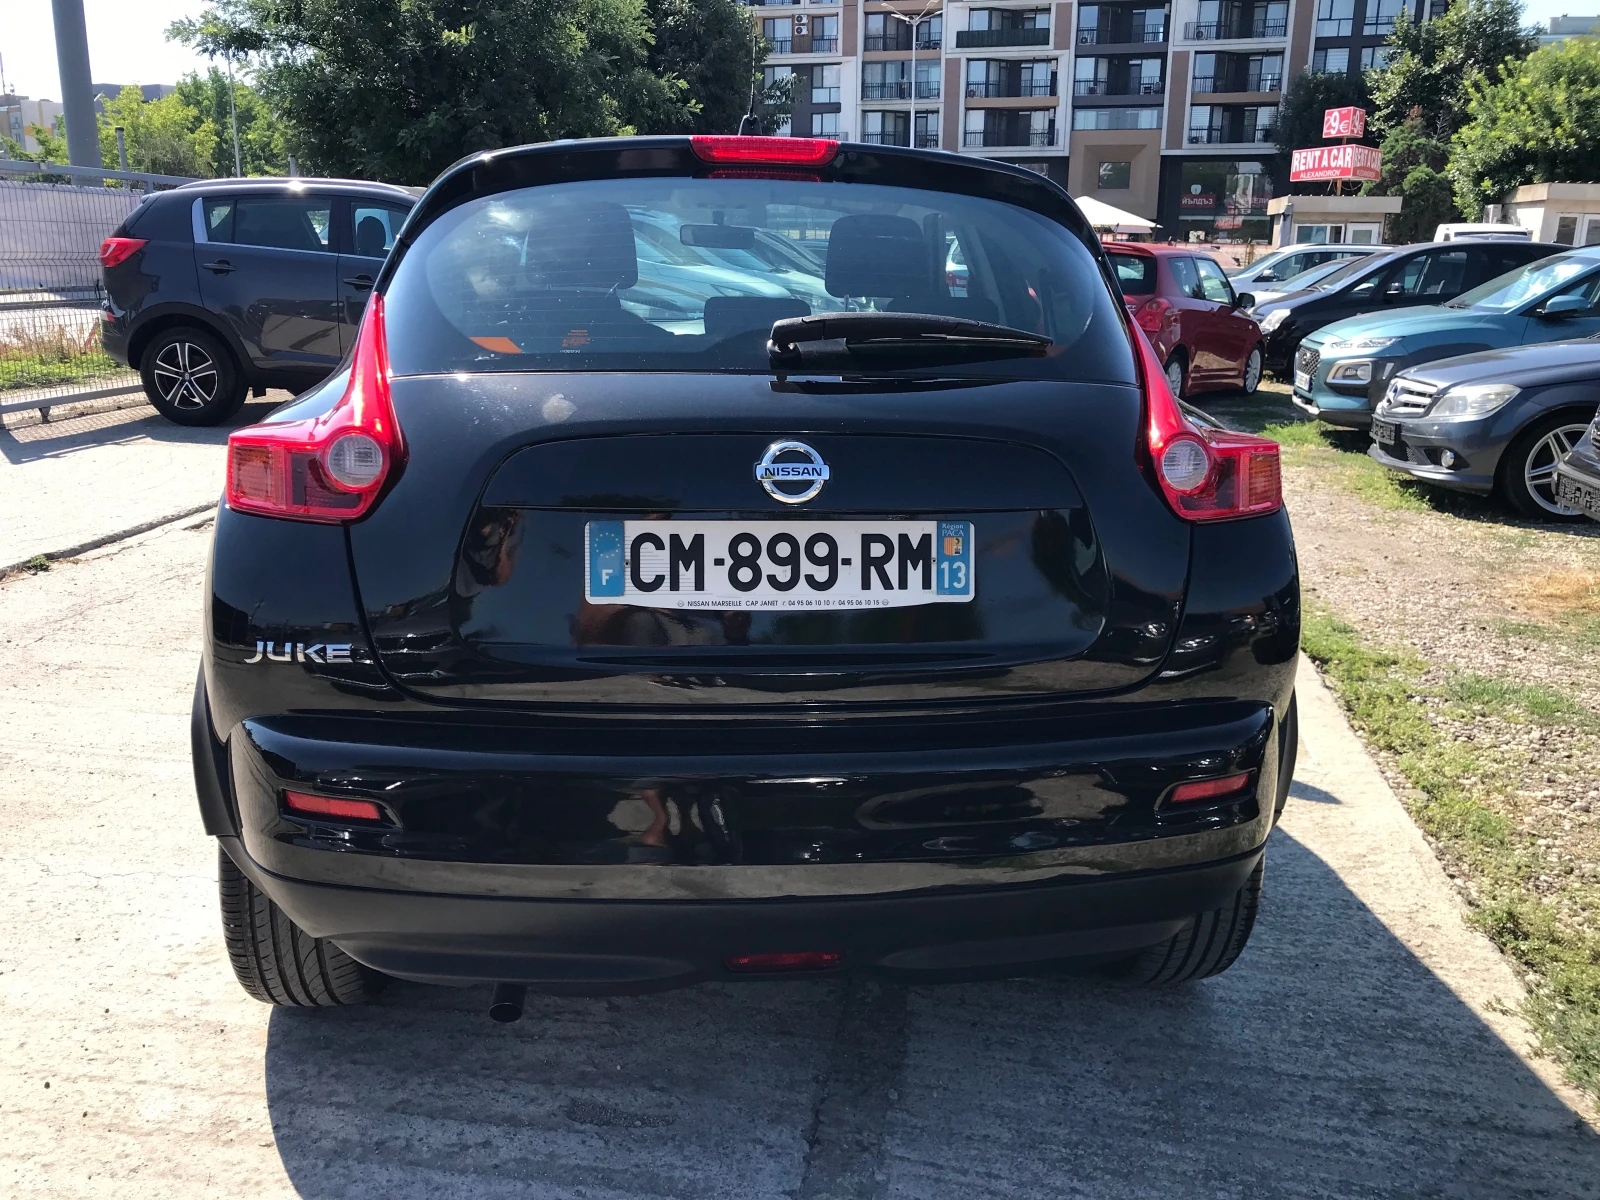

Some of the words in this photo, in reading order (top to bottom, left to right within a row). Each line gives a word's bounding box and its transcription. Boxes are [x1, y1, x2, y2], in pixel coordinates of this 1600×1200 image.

[1292, 150, 1321, 172] RENT
[1321, 149, 1329, 168] A
[1329, 147, 1353, 169] CAR
[1300, 169, 1341, 179] ALEXANDROV
[764, 467, 822, 477] NISSAN
[630, 532, 932, 592] CM-899-RM
[601, 569, 613, 586] F
[940, 561, 966, 589] 13
[243, 641, 353, 664] JUKE
